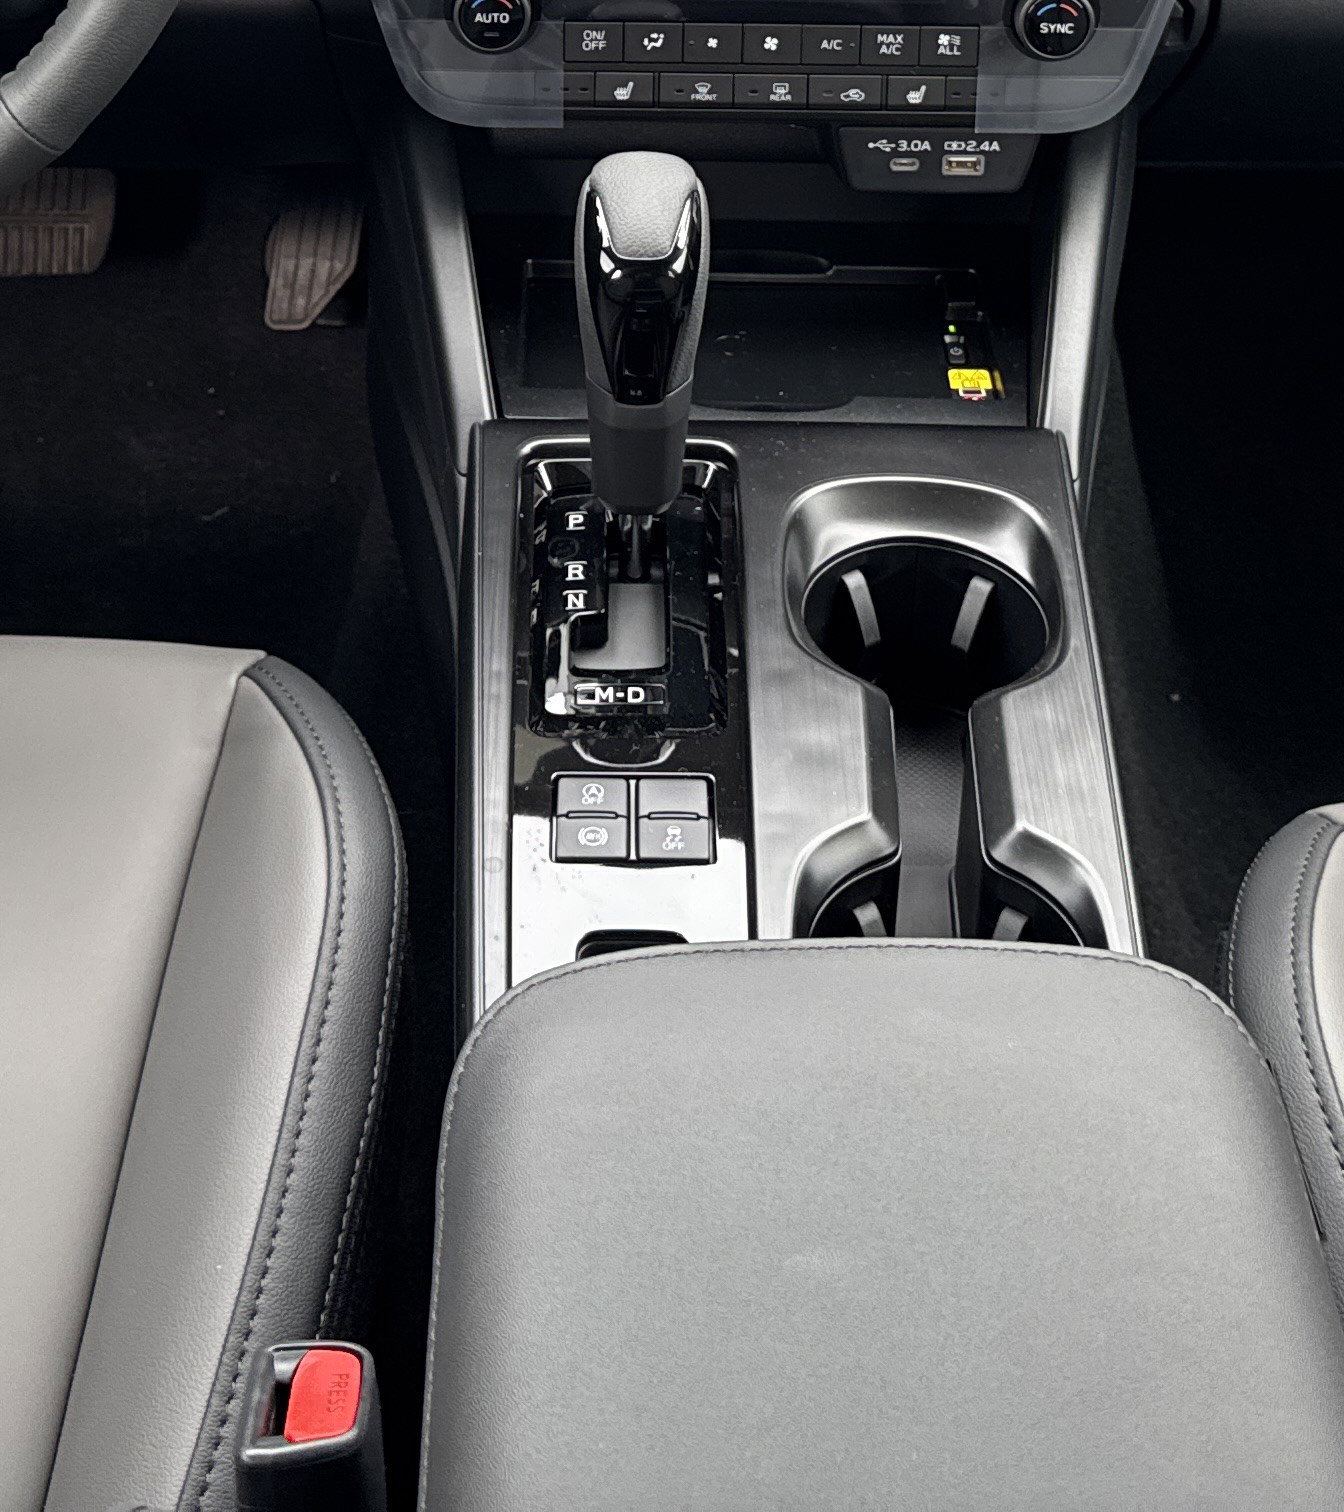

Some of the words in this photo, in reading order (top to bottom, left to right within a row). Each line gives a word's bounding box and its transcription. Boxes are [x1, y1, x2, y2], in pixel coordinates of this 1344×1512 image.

[473, 12, 511, 25] AUTO
[582, 29, 607, 41] ON/
[1039, 21, 1075, 36] SYNC
[820, 38, 844, 51] A/C
[876, 33, 904, 44] MAX
[581, 40, 608, 52] OFF
[878, 44, 902, 56] A/C
[936, 44, 962, 56] ALL
[690, 93, 719, 102] FRONT
[769, 93, 793, 102] REAR
[896, 140, 932, 153] 3.0A
[965, 140, 1001, 153] 2.4A
[567, 514, 584, 527] P
[567, 564, 585, 579] R
[567, 593, 584, 608] N
[594, 686, 645, 704] M-D
[581, 797, 605, 805] OFF
[661, 841, 686, 851] OFF
[325, 1372, 351, 1414] PRESS
